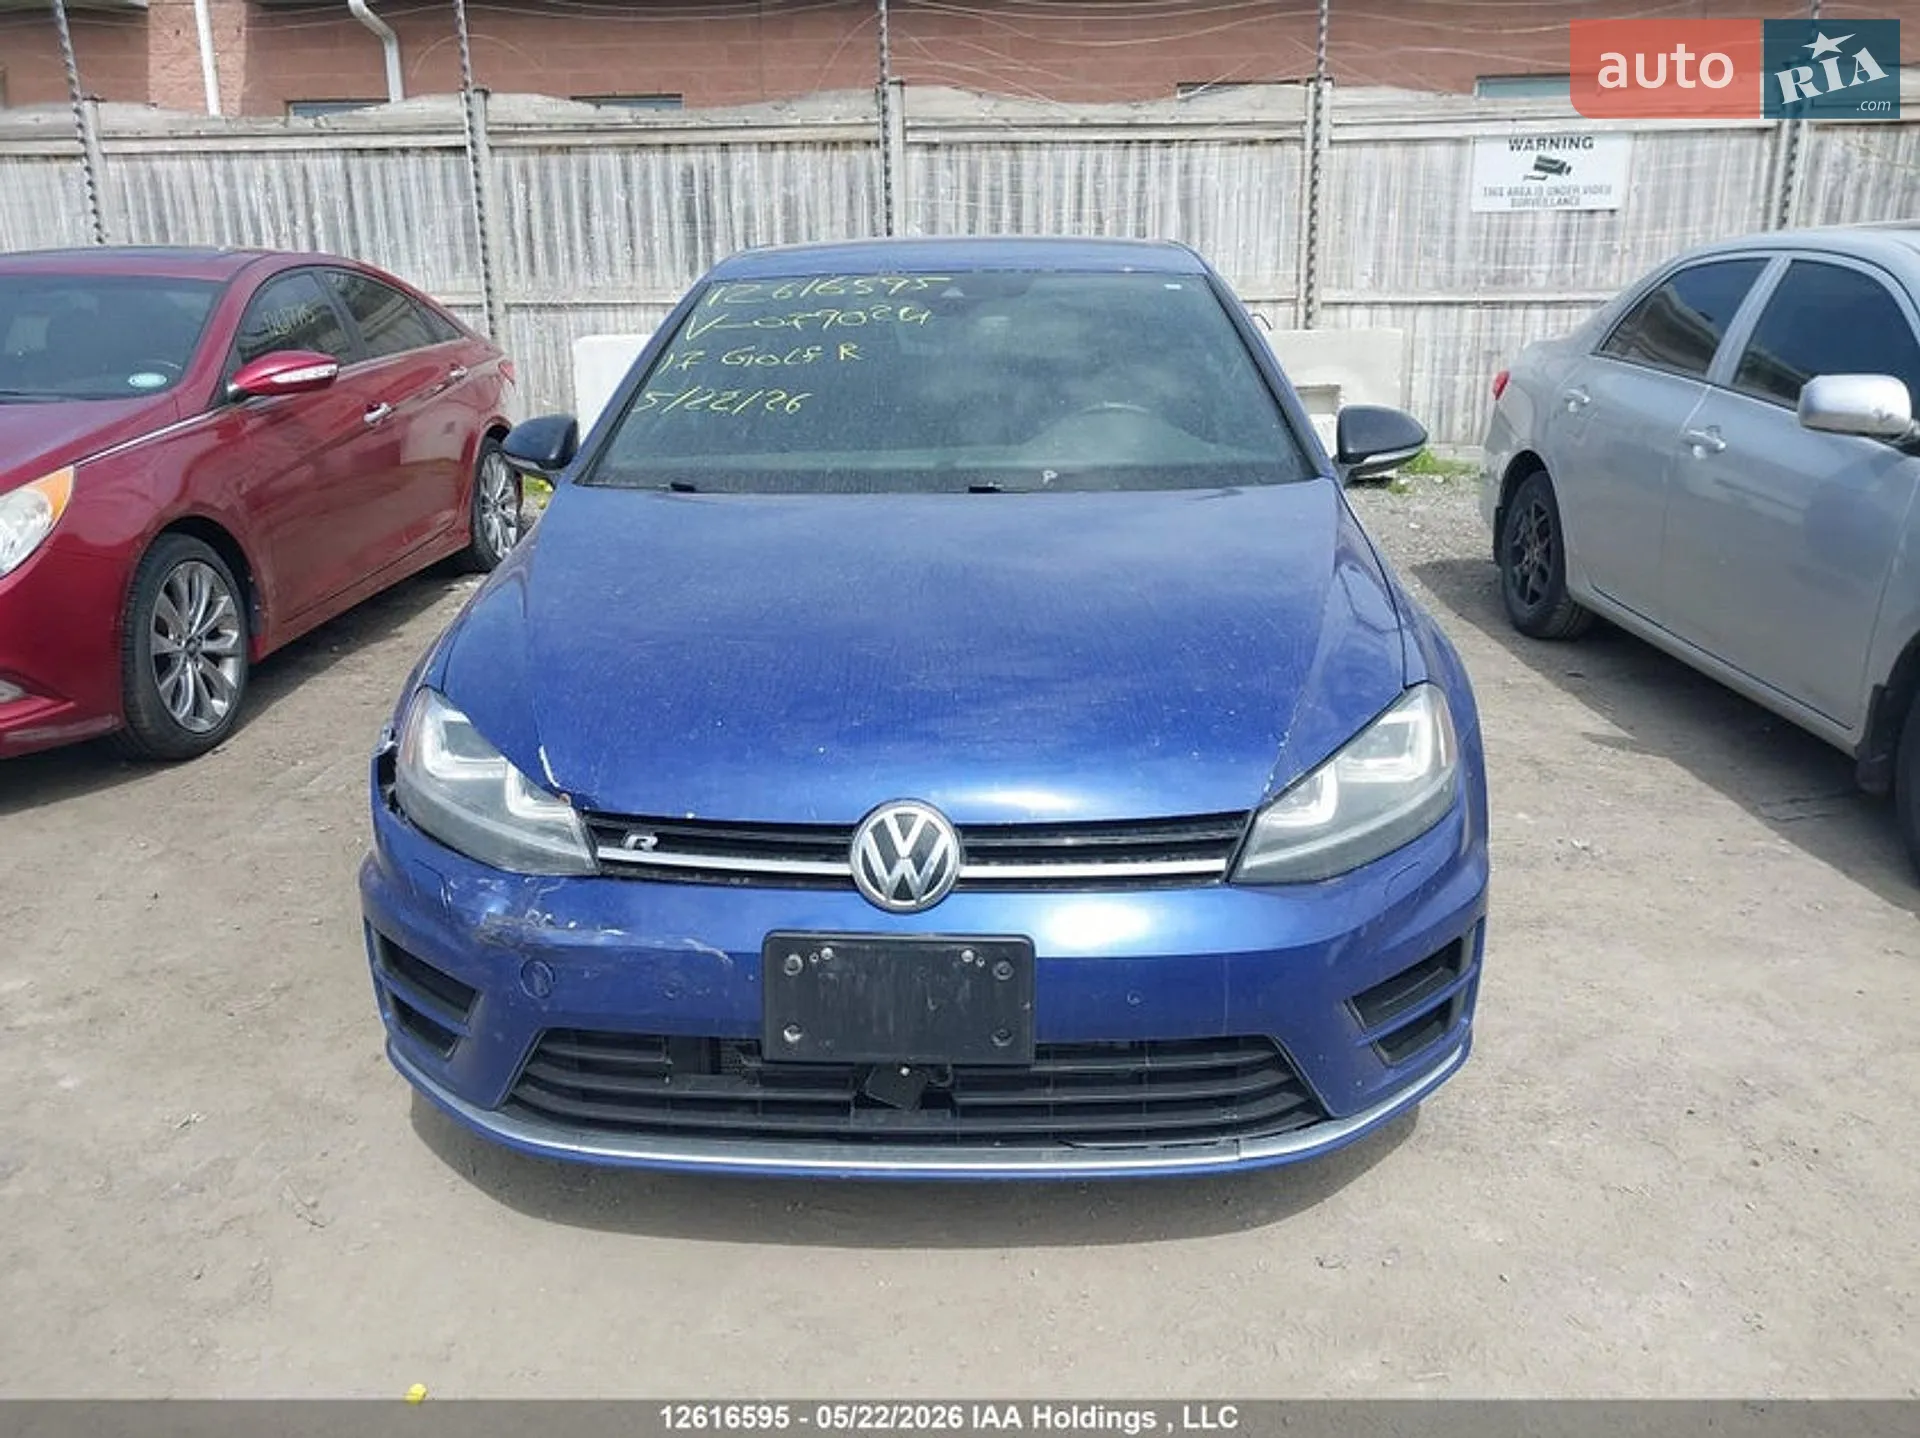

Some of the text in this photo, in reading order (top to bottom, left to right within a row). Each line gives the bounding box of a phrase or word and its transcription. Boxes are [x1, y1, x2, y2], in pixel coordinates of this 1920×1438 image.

[1508, 136, 1594, 152] WARNING
[838, 342, 863, 362] R
[631, 385, 814, 416] 5/22/26
[858, 805, 954, 905] VW
